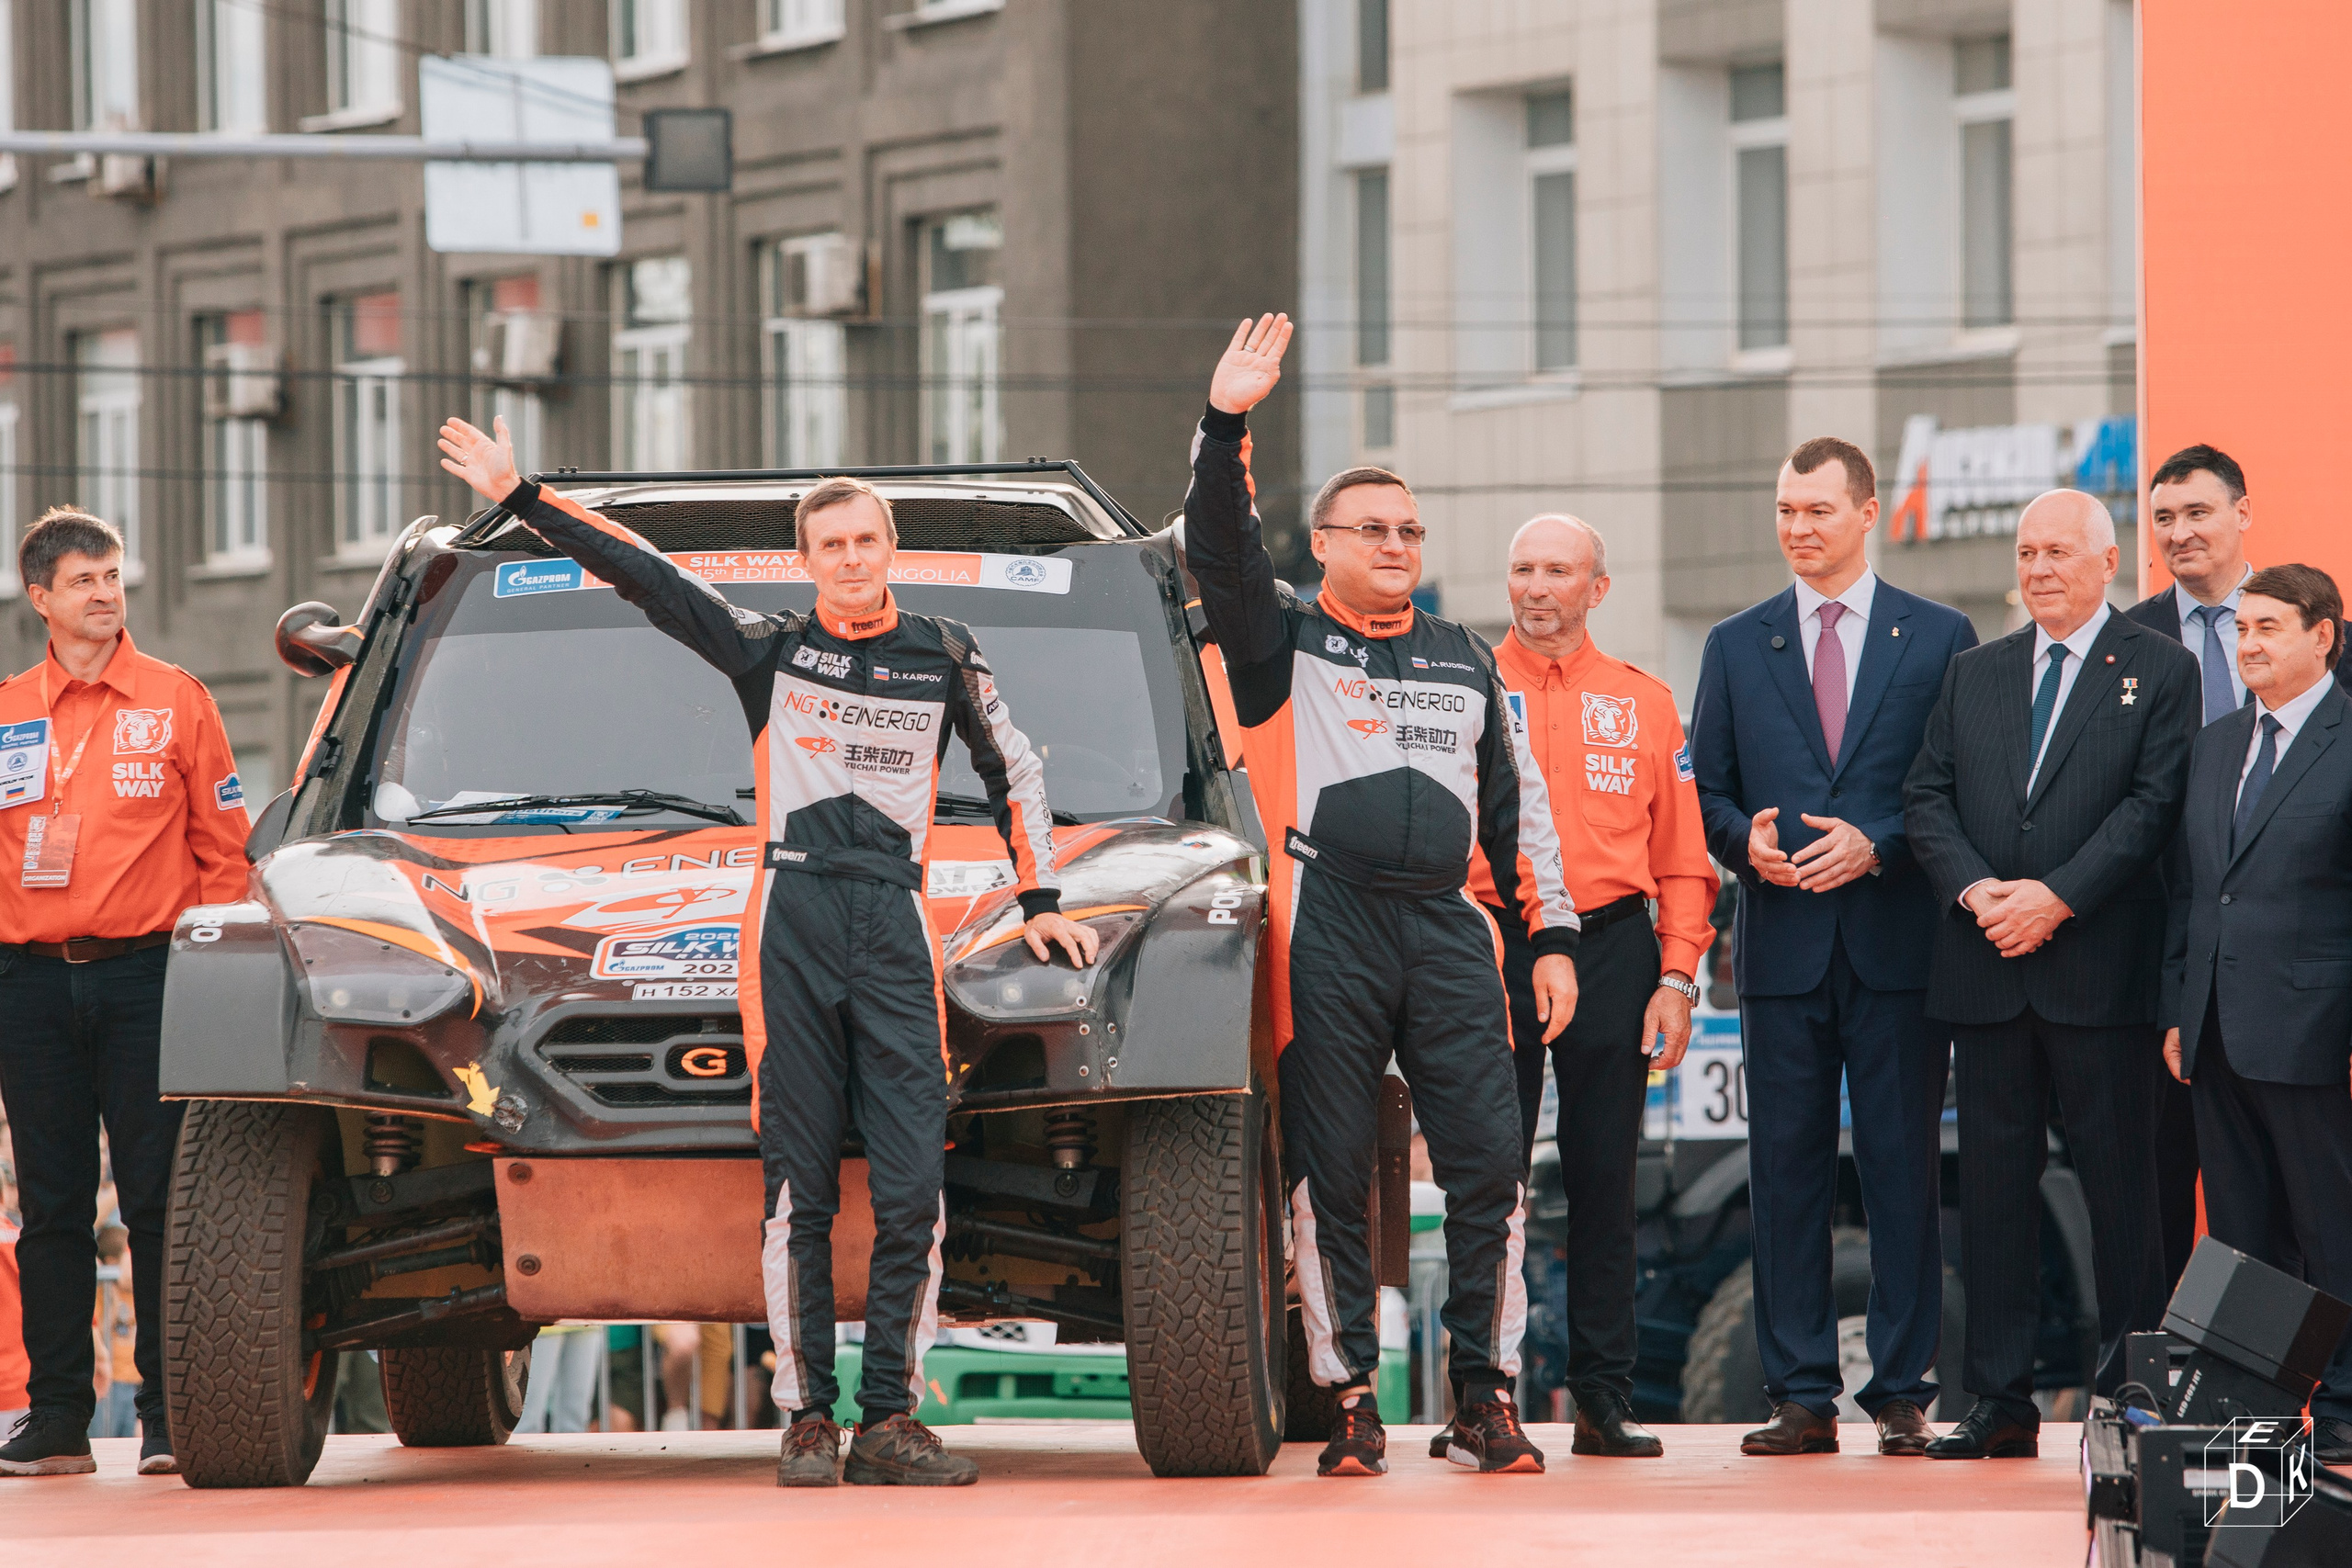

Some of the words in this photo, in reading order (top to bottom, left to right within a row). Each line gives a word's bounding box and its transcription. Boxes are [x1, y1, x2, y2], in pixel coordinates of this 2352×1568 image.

[689, 556, 740, 568] SILK
[746, 555, 798, 567] WAY
[526, 573, 571, 585] GAZPROM
[695, 568, 727, 580] 15th
[887, 568, 971, 582] NGOLIA
[852, 617, 884, 633] freem
[1371, 620, 1403, 632] freem
[820, 652, 853, 669] SILK
[817, 663, 851, 679] WAY
[892, 671, 901, 680] D.
[902, 672, 943, 682] KARPOV
[1334, 678, 1367, 699] NG
[1386, 691, 1465, 713] ENERGO
[784, 691, 819, 715] NG
[842, 705, 931, 732] ENERGO
[1430, 744, 1457, 754] POWER
[112, 762, 165, 780] SILK
[844, 761, 877, 772] YUCHAI
[879, 765, 910, 775] POWER
[1585, 753, 1636, 776] SILK
[112, 780, 165, 797] WAY
[1586, 772, 1635, 795] WAY
[772, 847, 808, 863] freem
[1289, 836, 1318, 860] freem
[421, 873, 524, 903] NG
[621, 846, 757, 879] ENE
[621, 941, 718, 955] SILK
[682, 964, 733, 975] 202
[663, 986, 709, 997] 152
[681, 1047, 728, 1077] G
